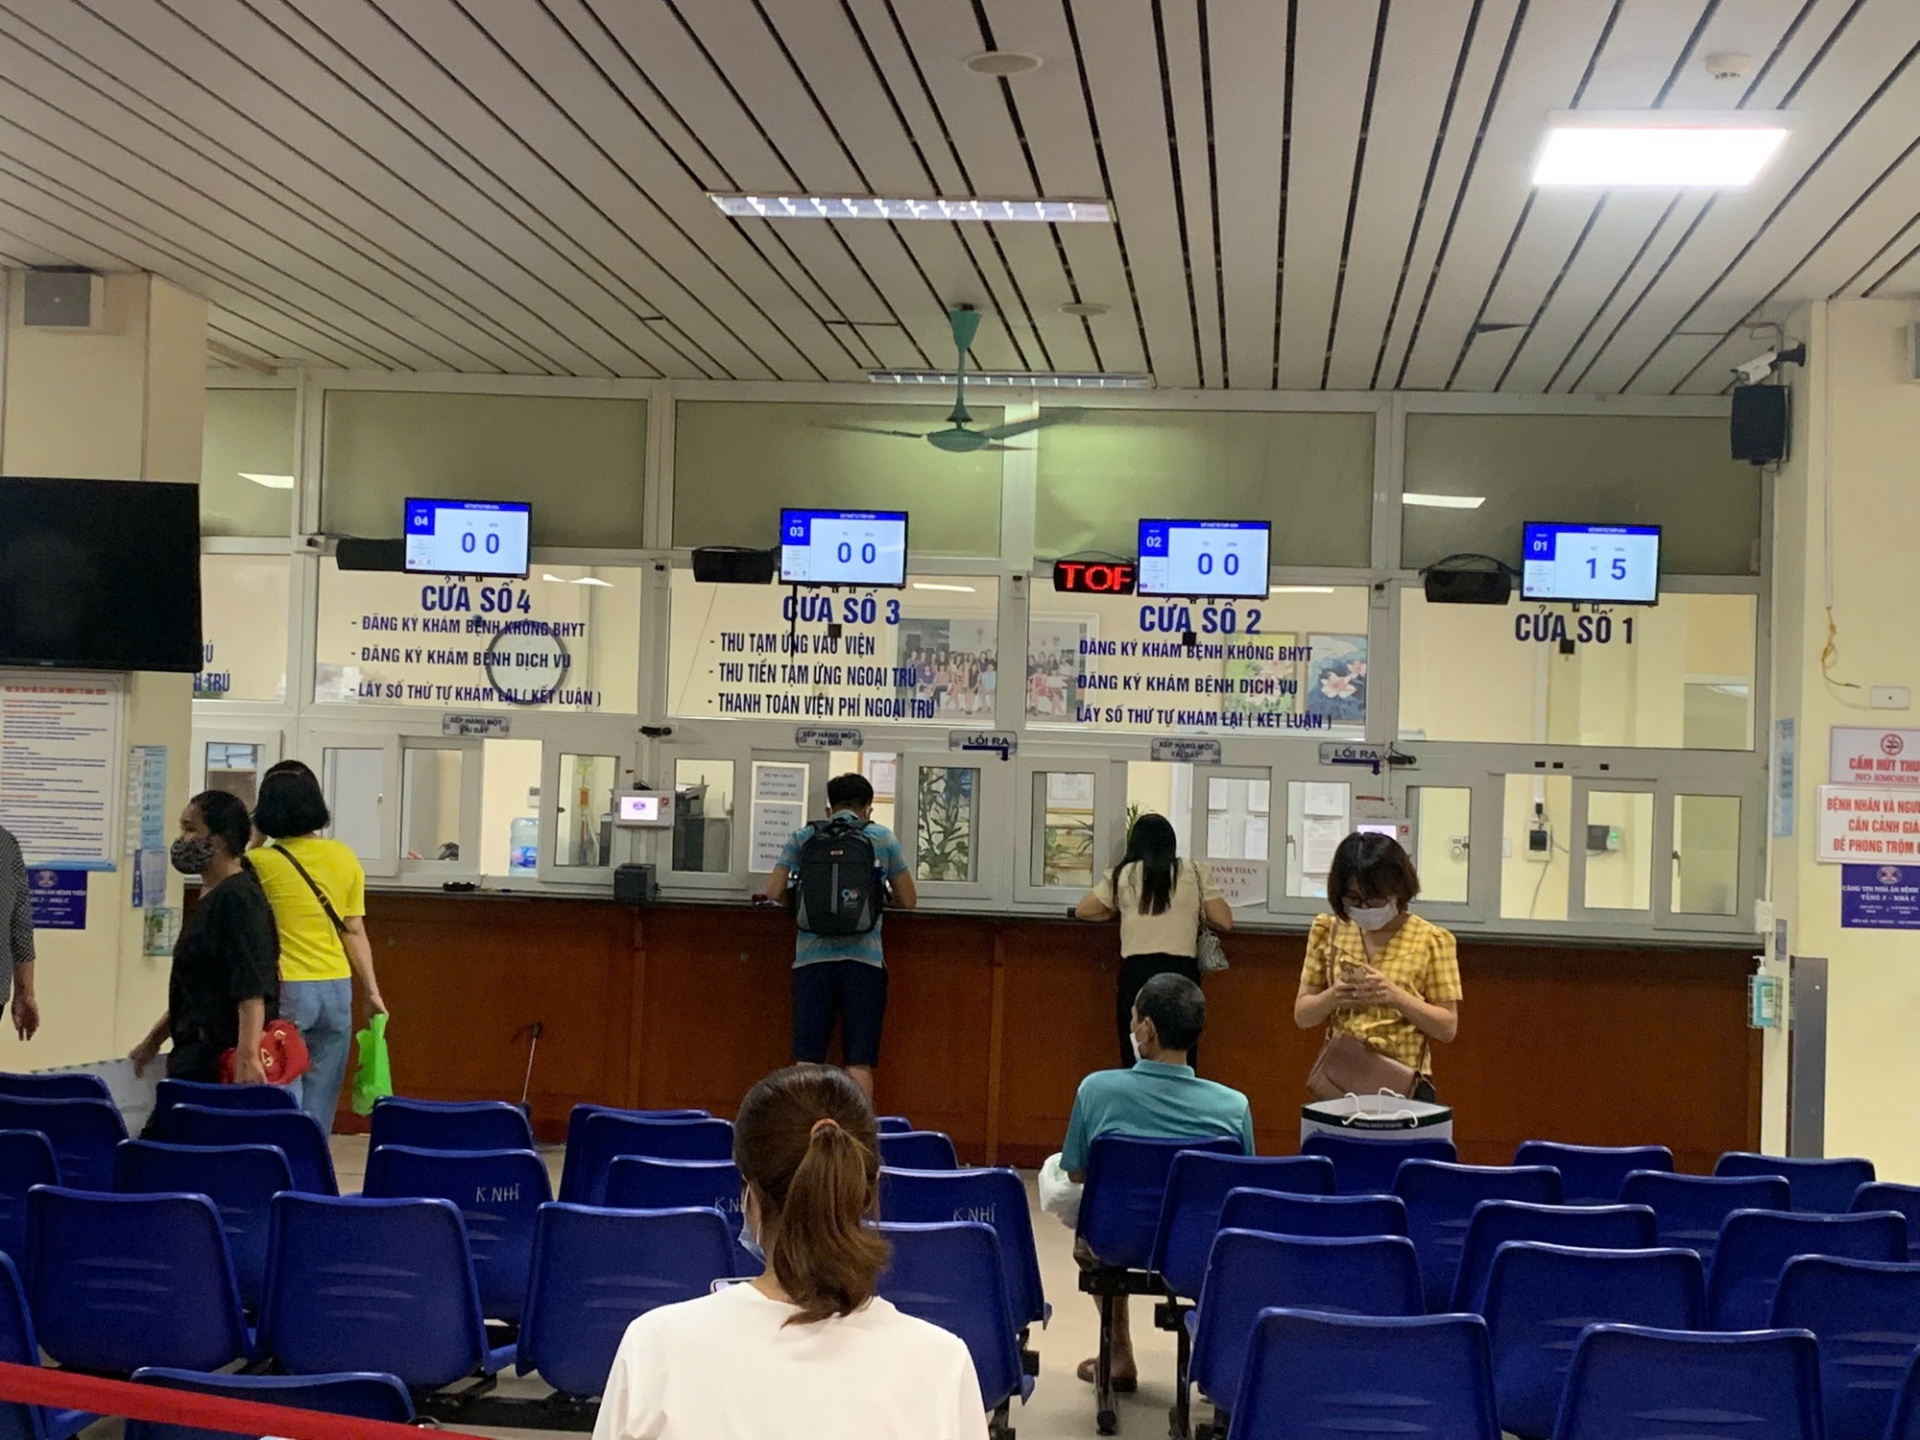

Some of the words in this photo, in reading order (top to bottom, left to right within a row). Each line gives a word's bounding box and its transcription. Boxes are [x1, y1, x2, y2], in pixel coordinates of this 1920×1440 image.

[413, 515, 429, 527] 04
[789, 526, 804, 537] 03
[1146, 536, 1162, 548] 02
[1533, 540, 1548, 552] 01
[421, 575, 471, 612] CỬA
[480, 580, 514, 613] SỐ
[517, 588, 531, 614] 4
[842, 589, 877, 625] SỐ
[885, 599, 900, 625] 3
[1201, 599, 1236, 635] SỐ
[1245, 608, 1261, 635] 2
[362, 612, 398, 631] ĐĂNG
[402, 614, 418, 632] KÝ
[423, 615, 460, 633] KHÁM
[505, 617, 549, 636] KHÔNG
[553, 622, 586, 637] BHYT
[1515, 604, 1567, 642] CỬA
[1577, 608, 1614, 644] SỐ
[1622, 617, 1633, 644] 1
[720, 632, 744, 652] THU
[749, 633, 777, 656] TẠM
[781, 630, 808, 654] ỨNG
[813, 632, 838, 654] VÀO
[845, 632, 875, 658] VIỆN
[1079, 637, 1116, 656] ĐĂNG
[1121, 638, 1138, 656] KÝ
[1142, 640, 1181, 658] KHÁM
[1187, 641, 1223, 661] BỆNH
[1227, 641, 1274, 660] KHÔNG
[1278, 646, 1313, 661] BHYT
[361, 644, 400, 663] ĐĂNG
[405, 646, 422, 663] KÝ
[427, 647, 468, 665] KHÁM
[516, 652, 549, 671] DỊCH
[553, 653, 571, 672] VỤ
[719, 662, 743, 682] THU
[781, 664, 808, 687] TẠM
[813, 661, 841, 685] ỨNG
[847, 665, 887, 690] NGOẠI
[892, 664, 916, 687] TRÚ
[1077, 671, 1118, 690] ĐĂNG
[1123, 672, 1142, 691] KÝ
[1146, 673, 1190, 692] KHÁM
[1195, 675, 1234, 697] BỆNH
[1240, 679, 1274, 697] DỊCH
[1279, 679, 1298, 699] VỤ
[358, 678, 382, 697] LẤY
[386, 679, 403, 699] SỐ
[408, 681, 433, 699] THỨ
[435, 685, 452, 705] TỰ
[455, 684, 494, 702] KHÁM
[498, 687, 518, 706] LẠI
[559, 687, 593, 709] LUẬN
[718, 693, 761, 713] THANH
[766, 691, 799, 714] TOÁN
[804, 692, 834, 719] VIỆN
[839, 693, 860, 717] PHÍ
[865, 697, 905, 721] NGOẠI
[910, 695, 934, 719] TRÚ
[1076, 703, 1101, 722] LẤY
[1105, 703, 1123, 723] SỐ
[1127, 705, 1155, 724] THỨ
[1157, 708, 1175, 728] TỰ
[1177, 708, 1217, 727] KHÁM
[1221, 711, 1243, 730] LẠI
[1257, 709, 1282, 728] KẾT
[1286, 710, 1322, 731] LUẬN
[992, 737, 1010, 745] RA
[1360, 750, 1378, 758] RA
[1849, 754, 1873, 770] CẤM
[1876, 757, 1896, 771] HÚT
[1900, 759, 1920, 772] THU
[1855, 773, 1872, 781] NO
[1874, 774, 1919, 783] SMOKIN
[1827, 796, 1852, 812] BỆNH
[1854, 796, 1880, 812] NHÂN
[1883, 797, 1895, 813] VÀ
[1872, 815, 1900, 833] CẢNH
[1903, 819, 1920, 834] GIÁ
[1849, 837, 1883, 853] PHÒNG
[1885, 838, 1914, 856] TRỘM
[476, 1186, 487, 1203] K
